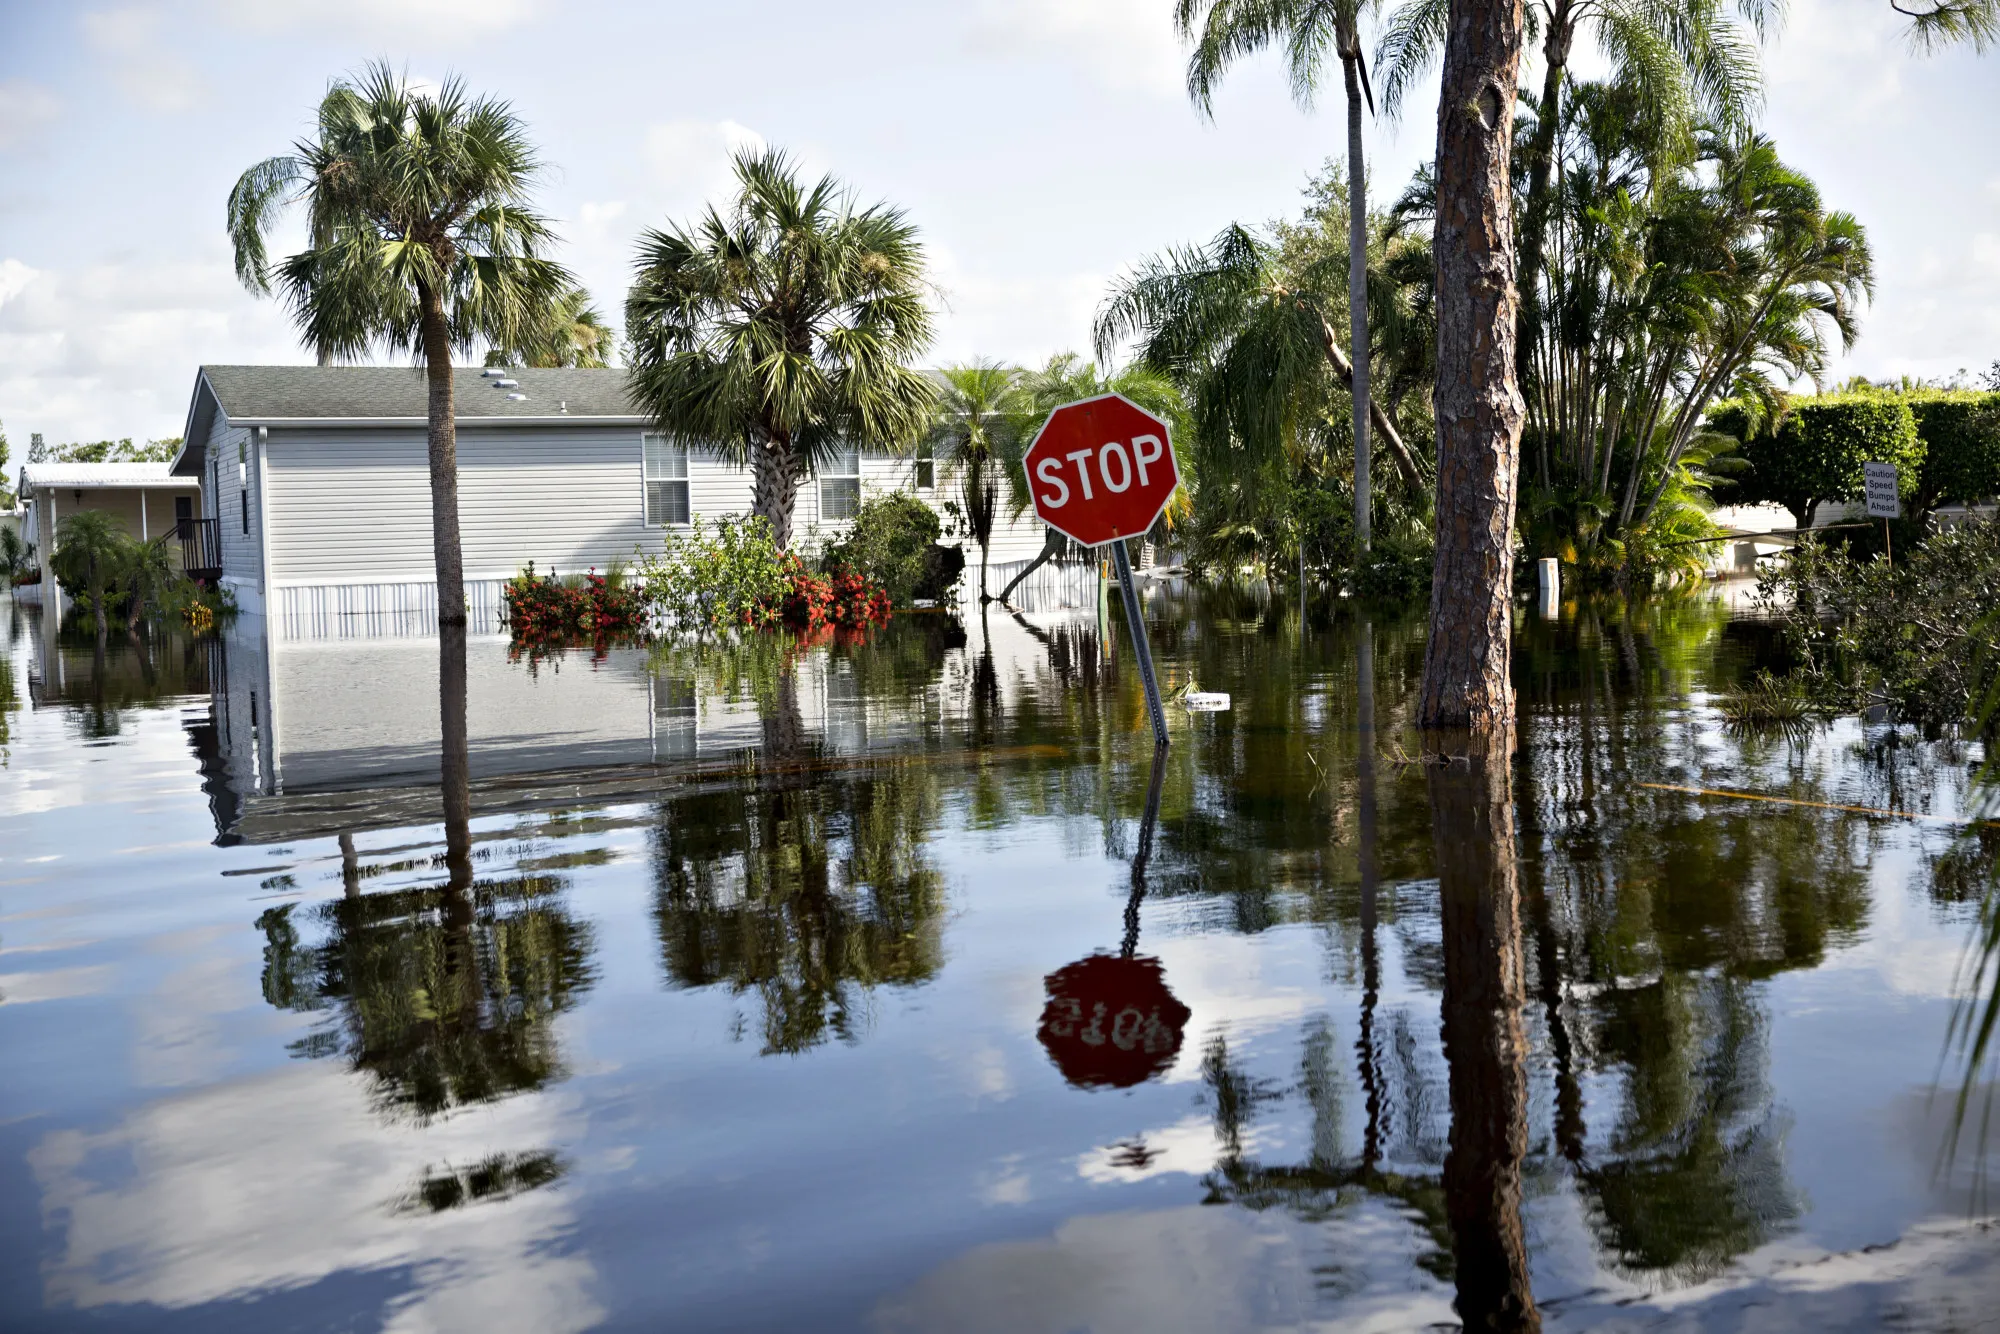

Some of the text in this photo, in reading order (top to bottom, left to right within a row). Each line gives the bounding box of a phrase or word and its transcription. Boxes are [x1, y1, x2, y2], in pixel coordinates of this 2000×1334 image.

[1036, 434, 1163, 509] STOP
[1865, 468, 1895, 479] Caution
[1869, 479, 1893, 490] Speed
[1868, 490, 1895, 502] Bumps
[1870, 501, 1895, 512] Ahead
